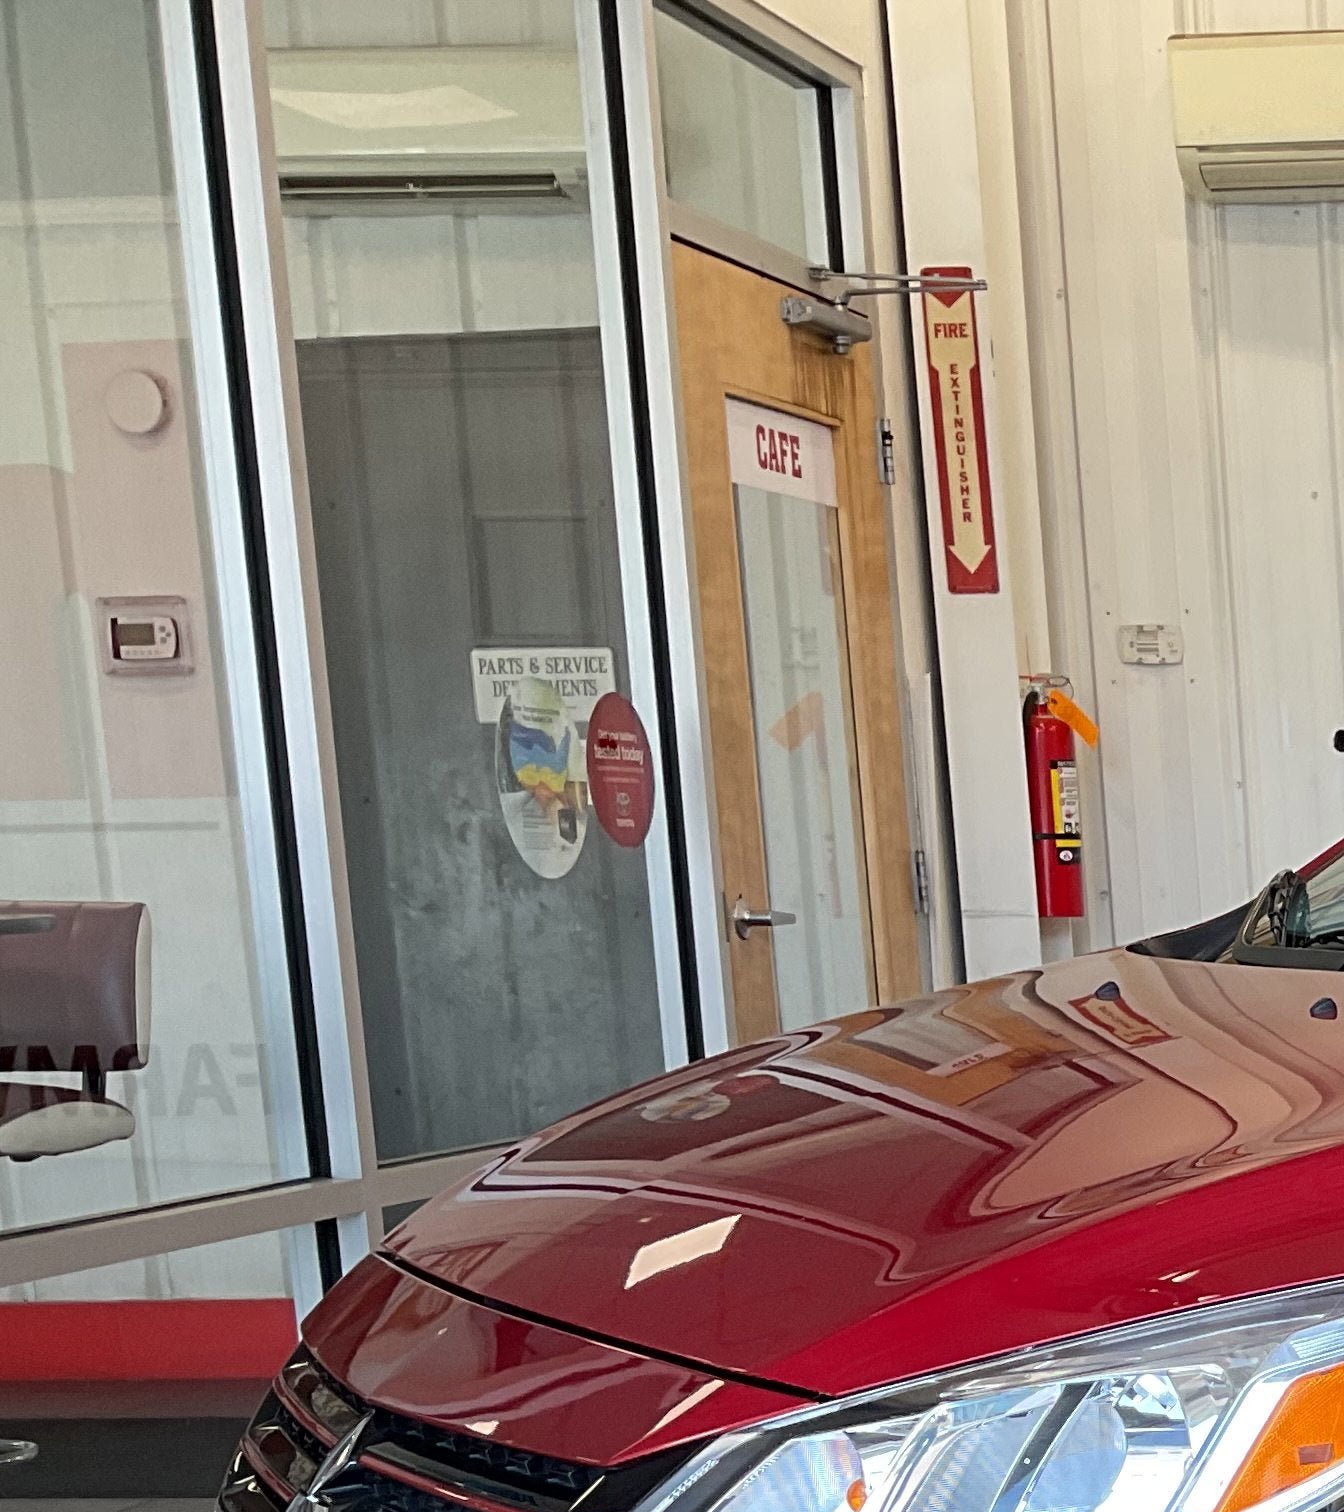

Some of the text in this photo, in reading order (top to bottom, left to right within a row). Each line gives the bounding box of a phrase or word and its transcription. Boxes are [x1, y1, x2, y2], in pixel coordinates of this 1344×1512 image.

[934, 322, 969, 338] FIRE
[755, 423, 803, 479] CAFE
[948, 363, 973, 523] EXTINGUISHER
[478, 656, 608, 675] PARTS & SERVICE
[594, 744, 644, 765] tested today
